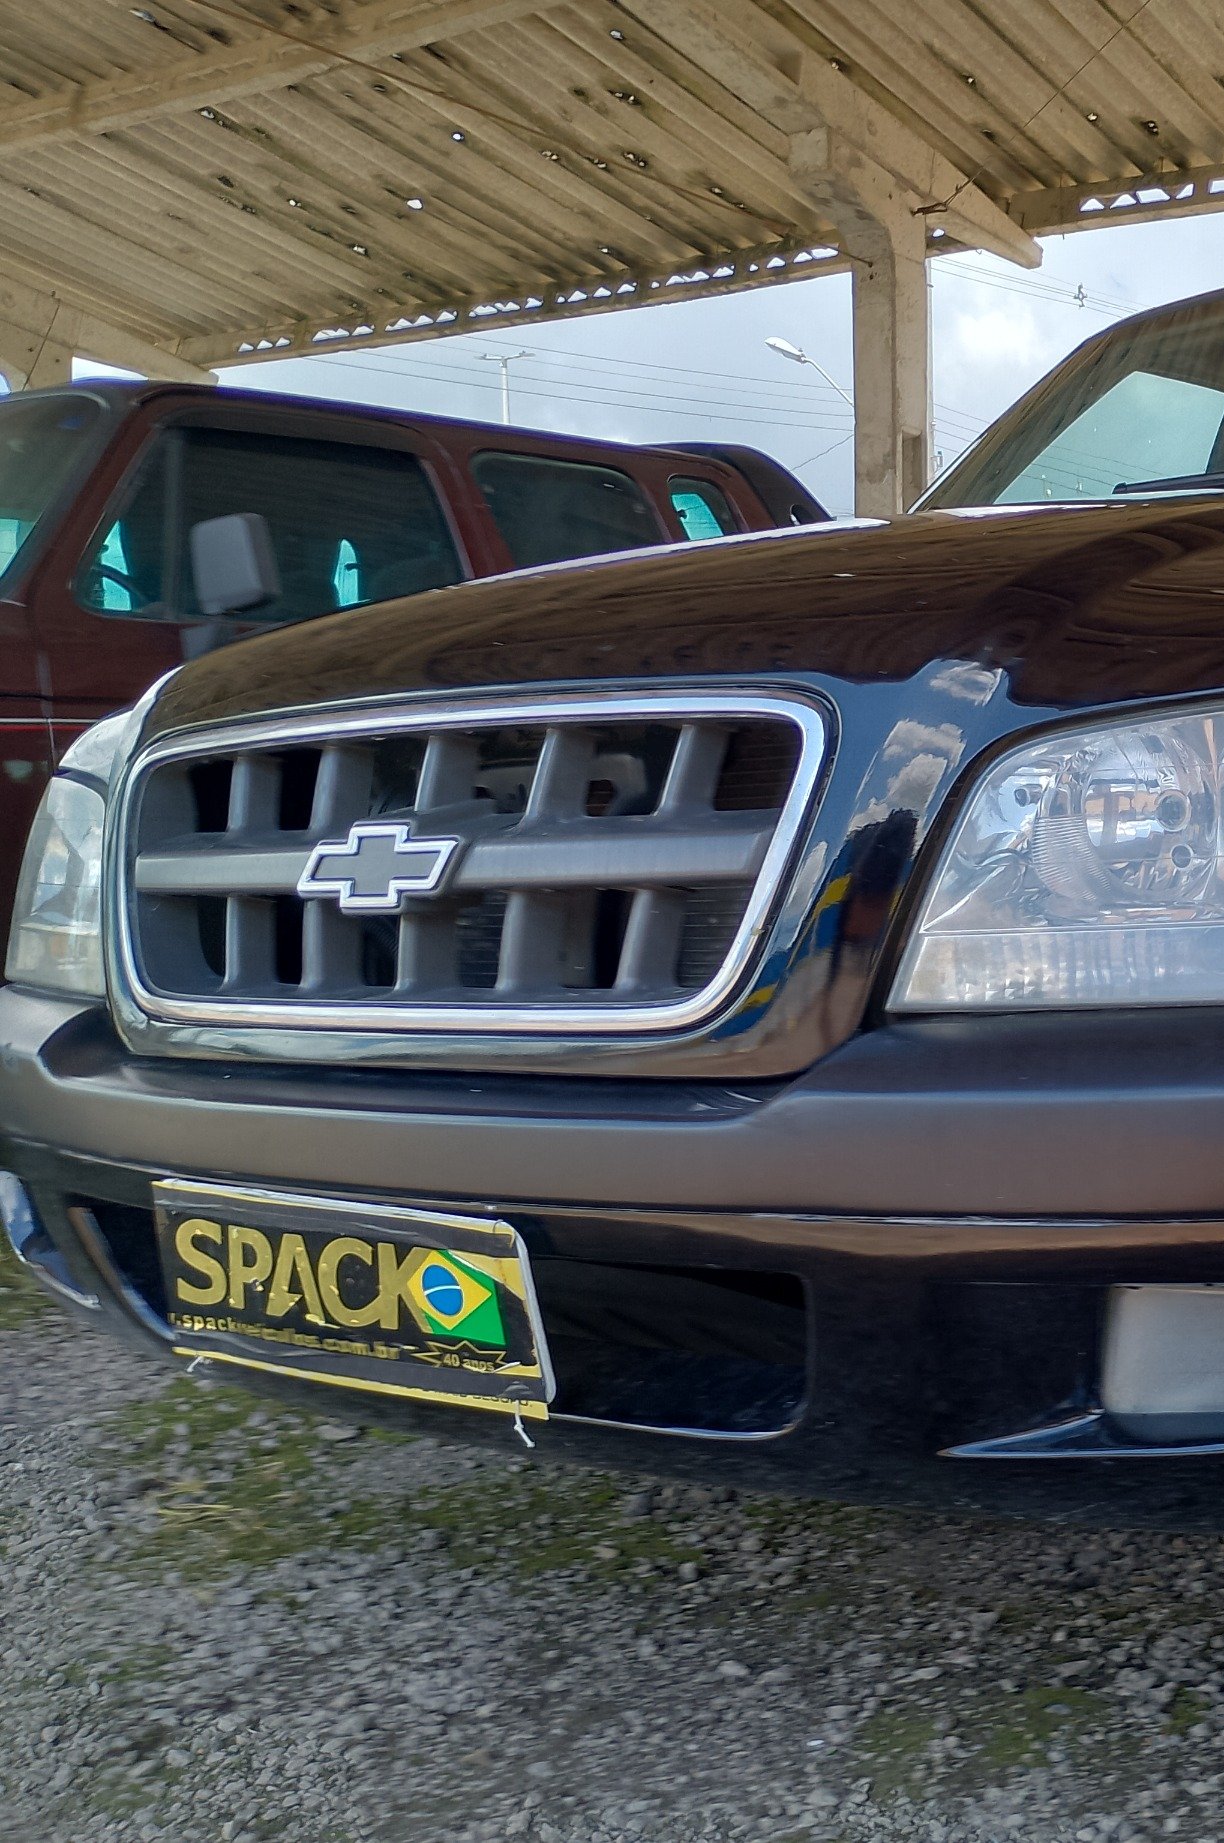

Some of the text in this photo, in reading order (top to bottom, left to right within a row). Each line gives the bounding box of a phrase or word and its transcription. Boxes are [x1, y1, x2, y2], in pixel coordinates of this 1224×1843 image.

[175, 1218, 432, 1332] SPACK
[443, 1353, 495, 1373] 40 anos
